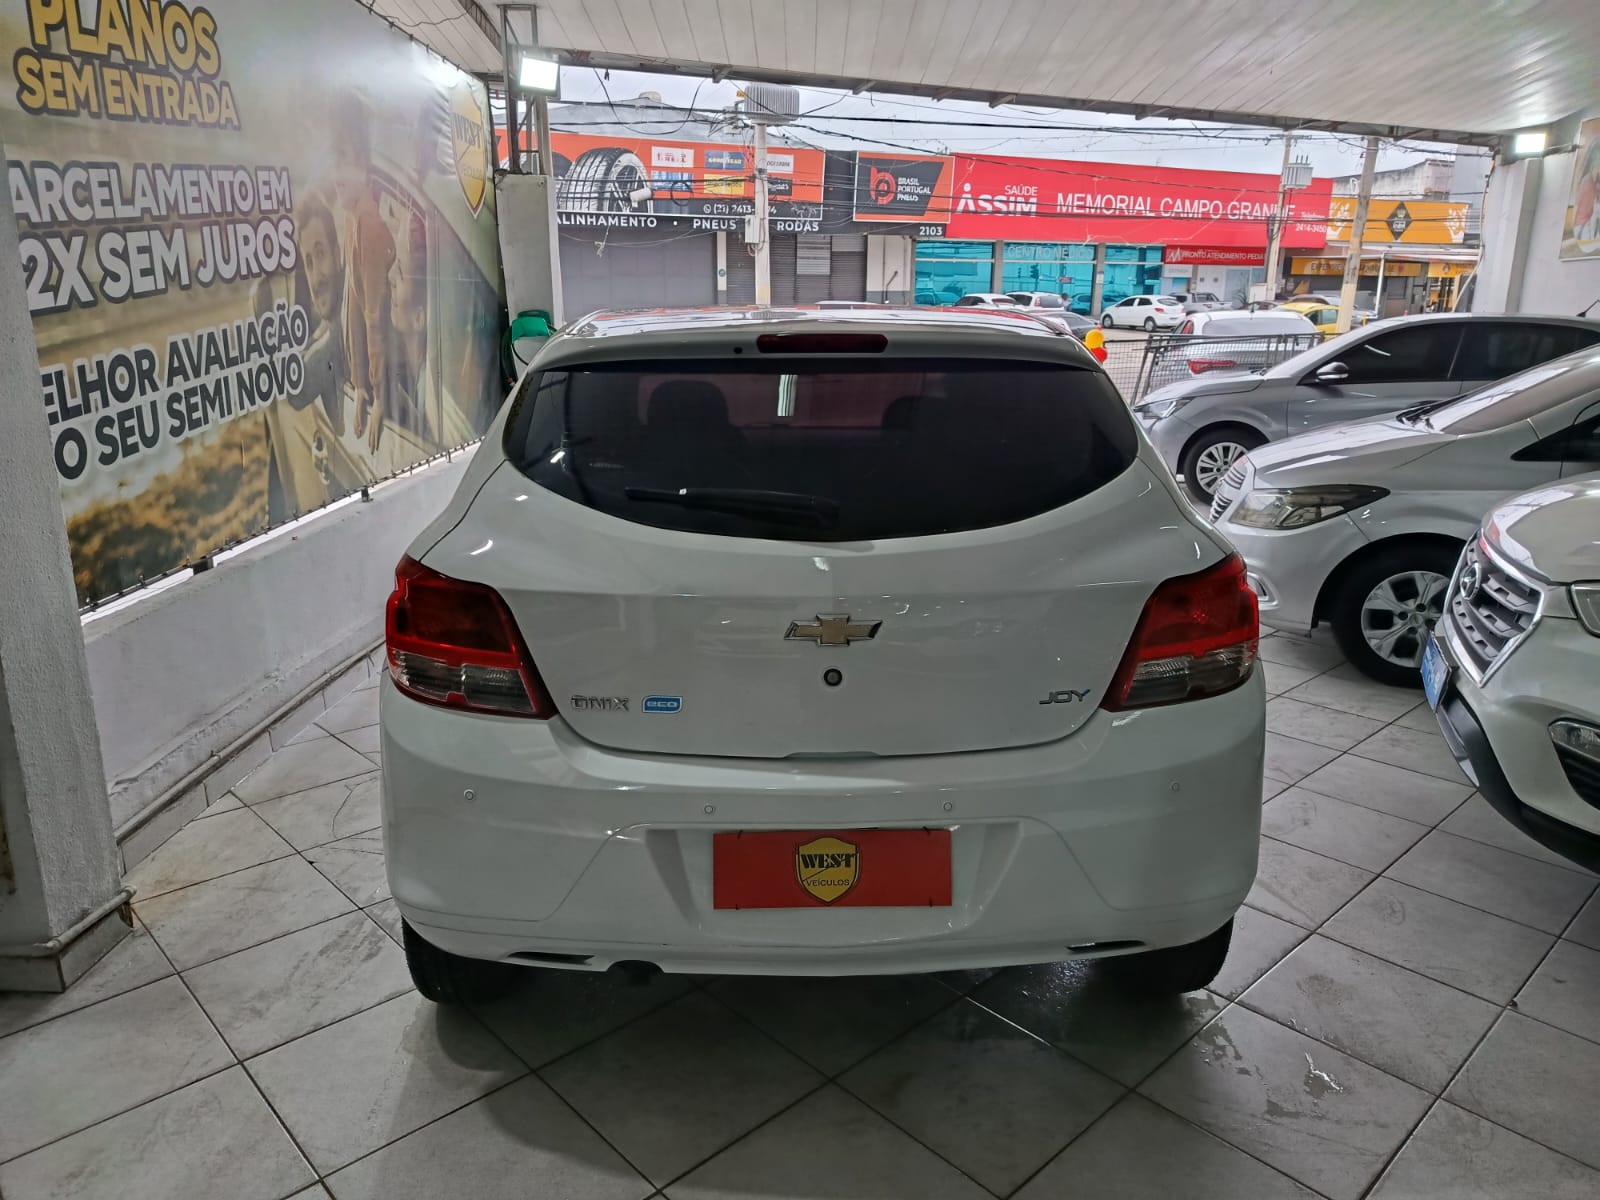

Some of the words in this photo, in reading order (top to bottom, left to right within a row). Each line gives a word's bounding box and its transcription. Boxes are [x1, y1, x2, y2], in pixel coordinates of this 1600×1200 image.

[29, 0, 220, 77] PLANOS
[16, 53, 99, 114] SEM
[102, 66, 240, 128] ENTRADA
[897, 177, 919, 186] BRASIL
[897, 185, 931, 194] PORTUGAL
[8, 166, 254, 223] ARCELAMENTO
[257, 169, 292, 212] EM
[896, 193, 919, 202] PNEUS
[1004, 184, 1039, 196] SAÚDE
[1056, 192, 1156, 217] MEMORIAL
[1160, 197, 1223, 219] CAMPO
[693, 218, 737, 230] PNEUS
[776, 221, 819, 232] RODAS
[919, 226, 943, 236] 2103
[99, 227, 190, 299] SEM
[197, 218, 297, 283] JUROS
[166, 303, 307, 389] AVALIAÇÃO
[95, 400, 160, 466] SEU
[166, 375, 232, 438] SEMI
[236, 352, 303, 411] NOVO
[571, 694, 629, 711] ONIX
[1039, 689, 1090, 704] JOY
[800, 853, 854, 869] WEST
